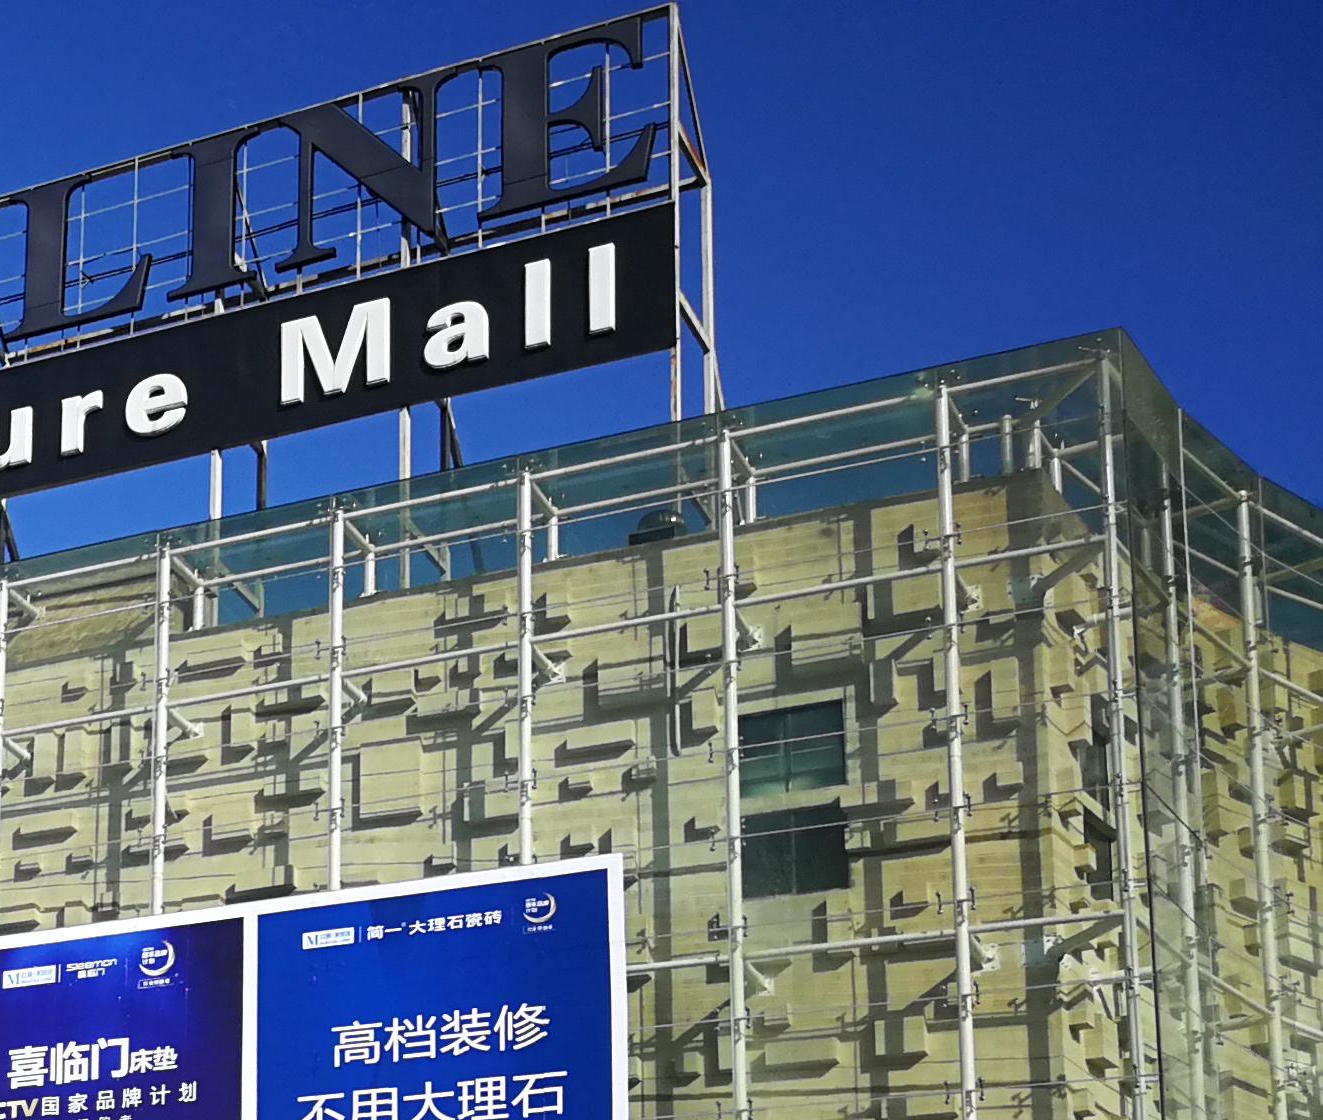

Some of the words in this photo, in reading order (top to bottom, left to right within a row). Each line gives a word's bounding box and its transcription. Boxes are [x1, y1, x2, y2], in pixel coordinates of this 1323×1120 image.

[280, 242, 616, 407] Mall
[7, 1037, 178, 1090] 喜临门床垫
[331, 1002, 550, 1067] 高档装修
